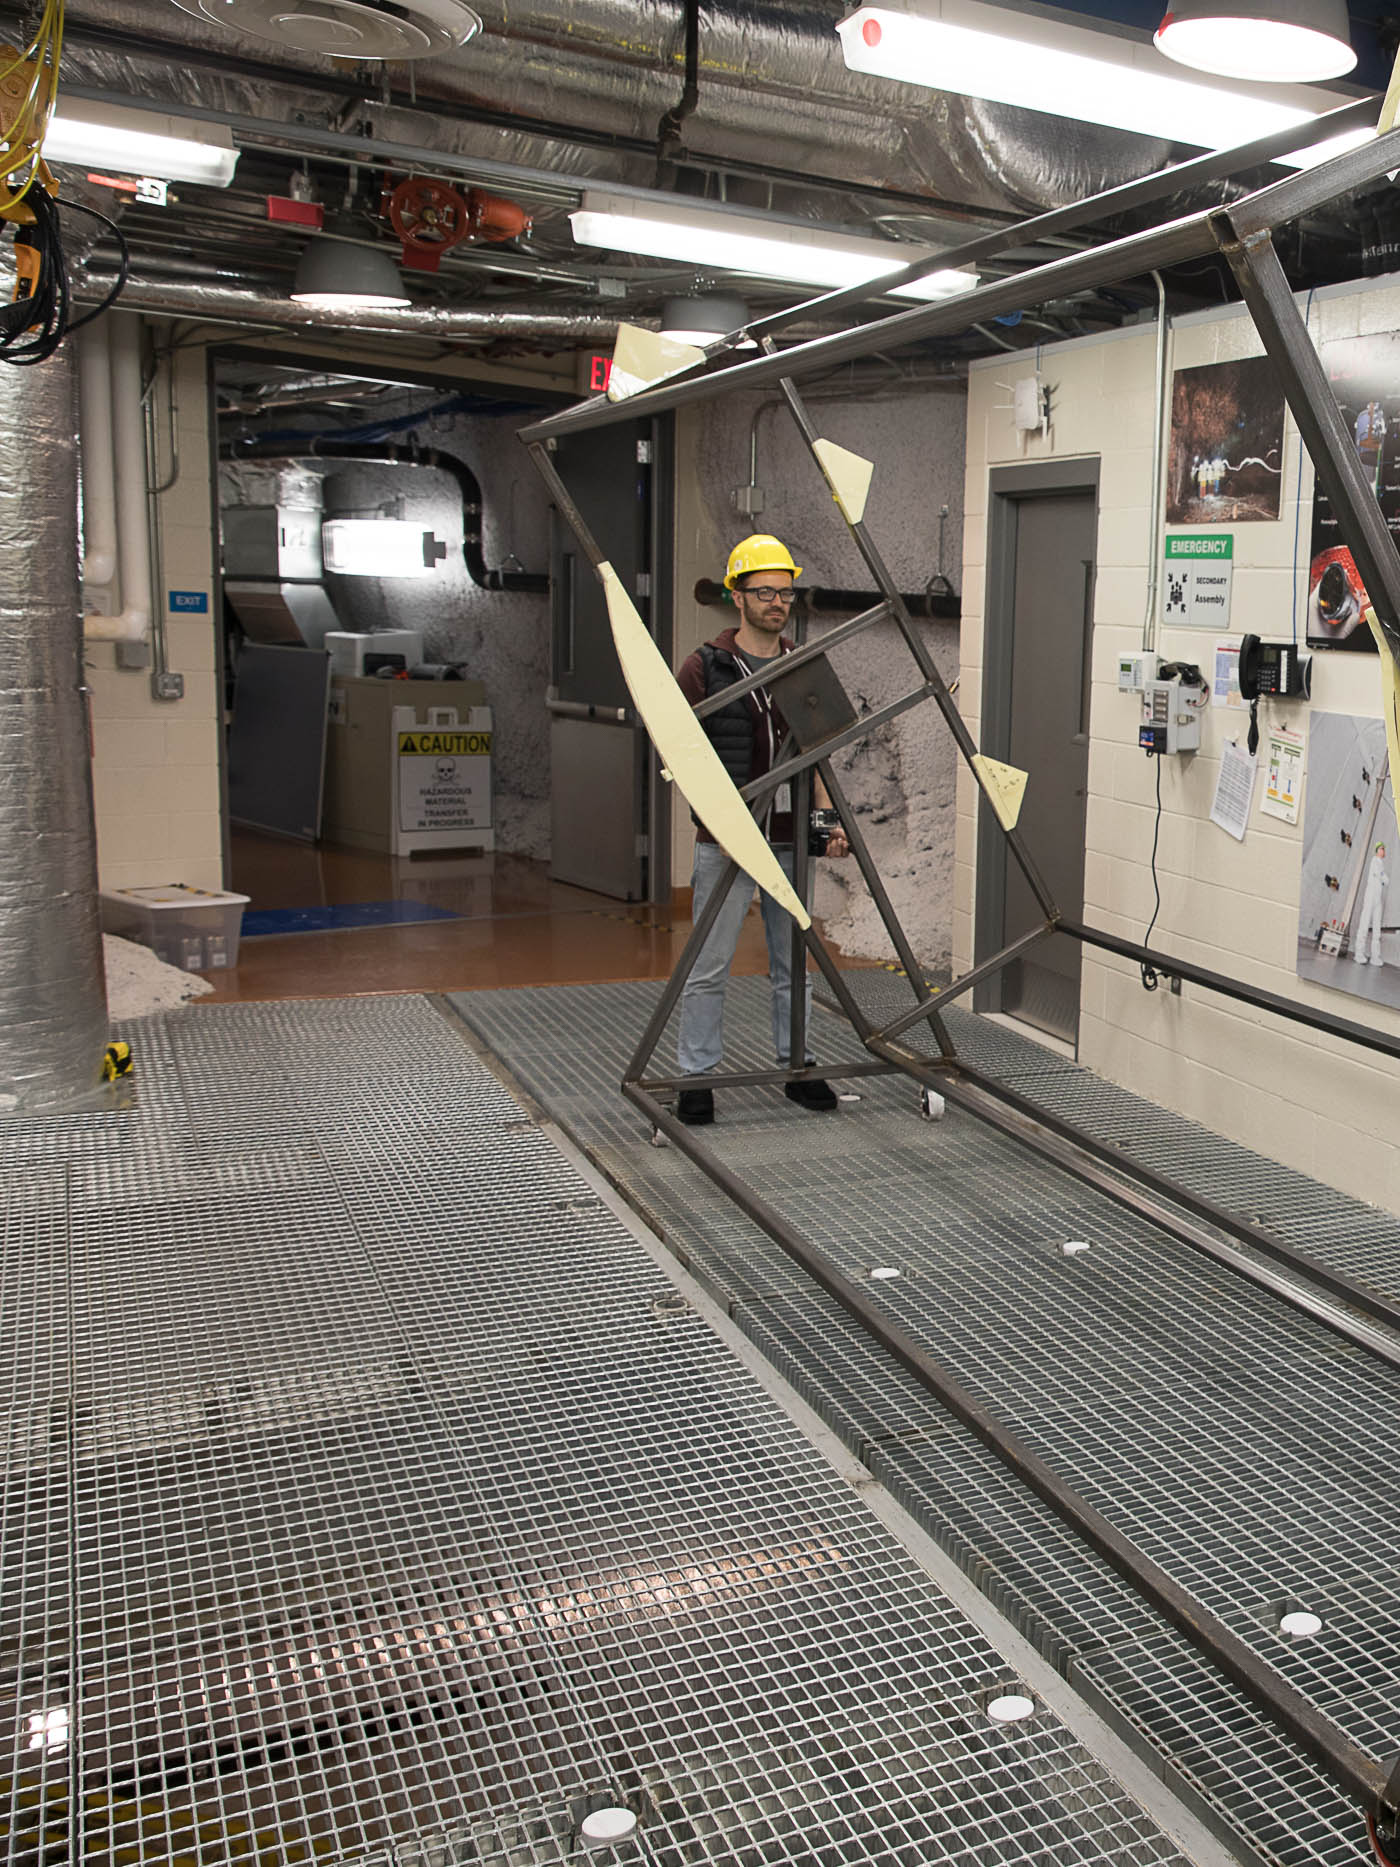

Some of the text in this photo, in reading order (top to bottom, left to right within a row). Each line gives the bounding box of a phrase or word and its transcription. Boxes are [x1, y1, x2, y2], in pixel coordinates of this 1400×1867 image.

[1171, 540, 1228, 554] EMERGENCY
[176, 595, 200, 606] EXIT
[1195, 594, 1225, 607] Assembly
[419, 735, 490, 753] CAUTION
[419, 788, 473, 796] HAZARDOUS
[425, 798, 467, 806] MATERIAL
[424, 809, 469, 817] TRANSFER
[417, 818, 475, 828] IN PROGRESS
